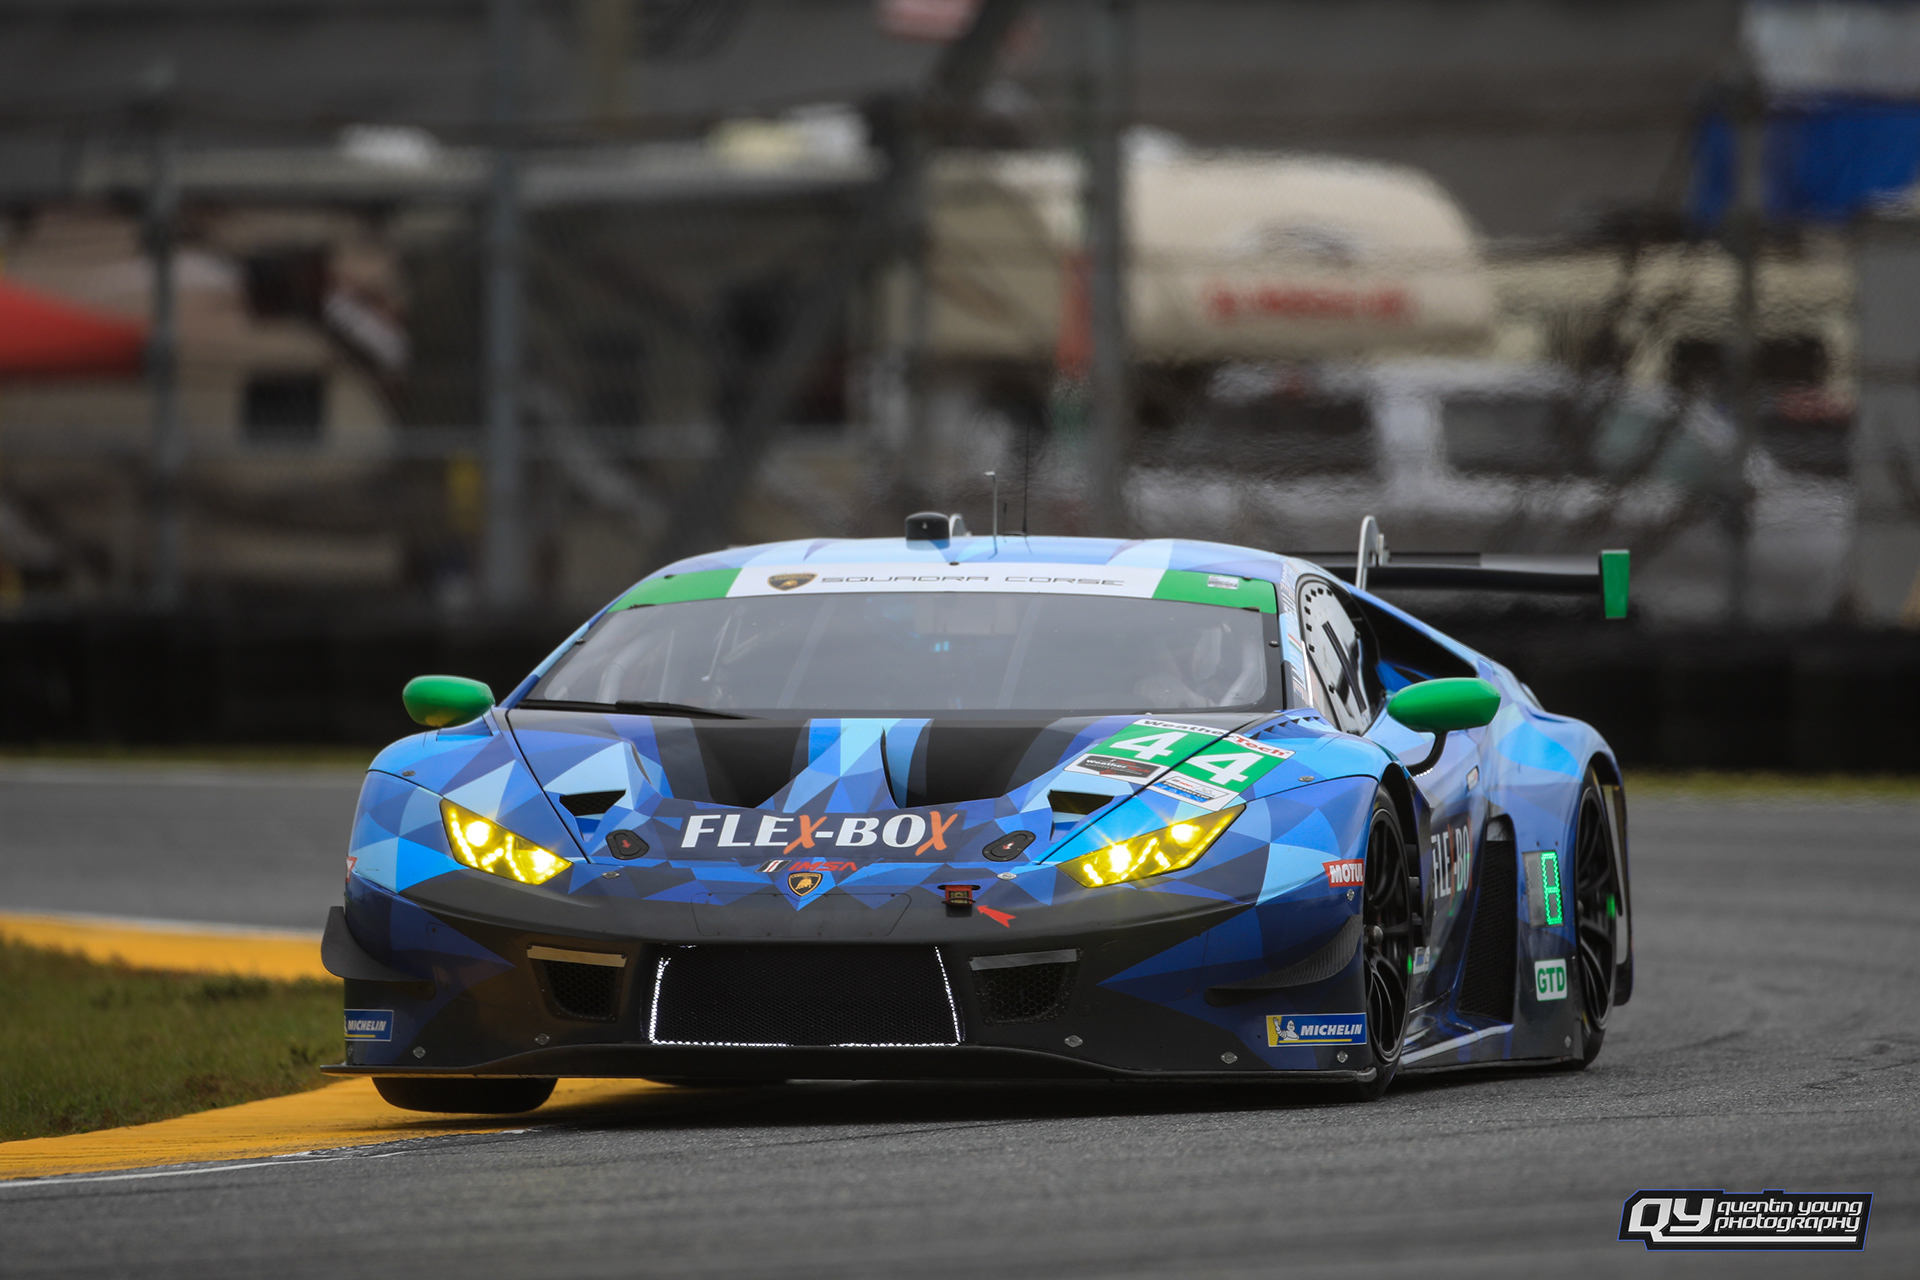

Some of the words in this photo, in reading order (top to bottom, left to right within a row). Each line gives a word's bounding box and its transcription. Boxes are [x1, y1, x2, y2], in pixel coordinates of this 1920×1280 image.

[1004, 576, 1125, 586] CORSE
[680, 810, 959, 856] FLEX-BOX
[1536, 966, 1566, 994] GTD
[347, 1020, 387, 1031] MICHELIN
[1300, 1024, 1363, 1036] MICHELIN
